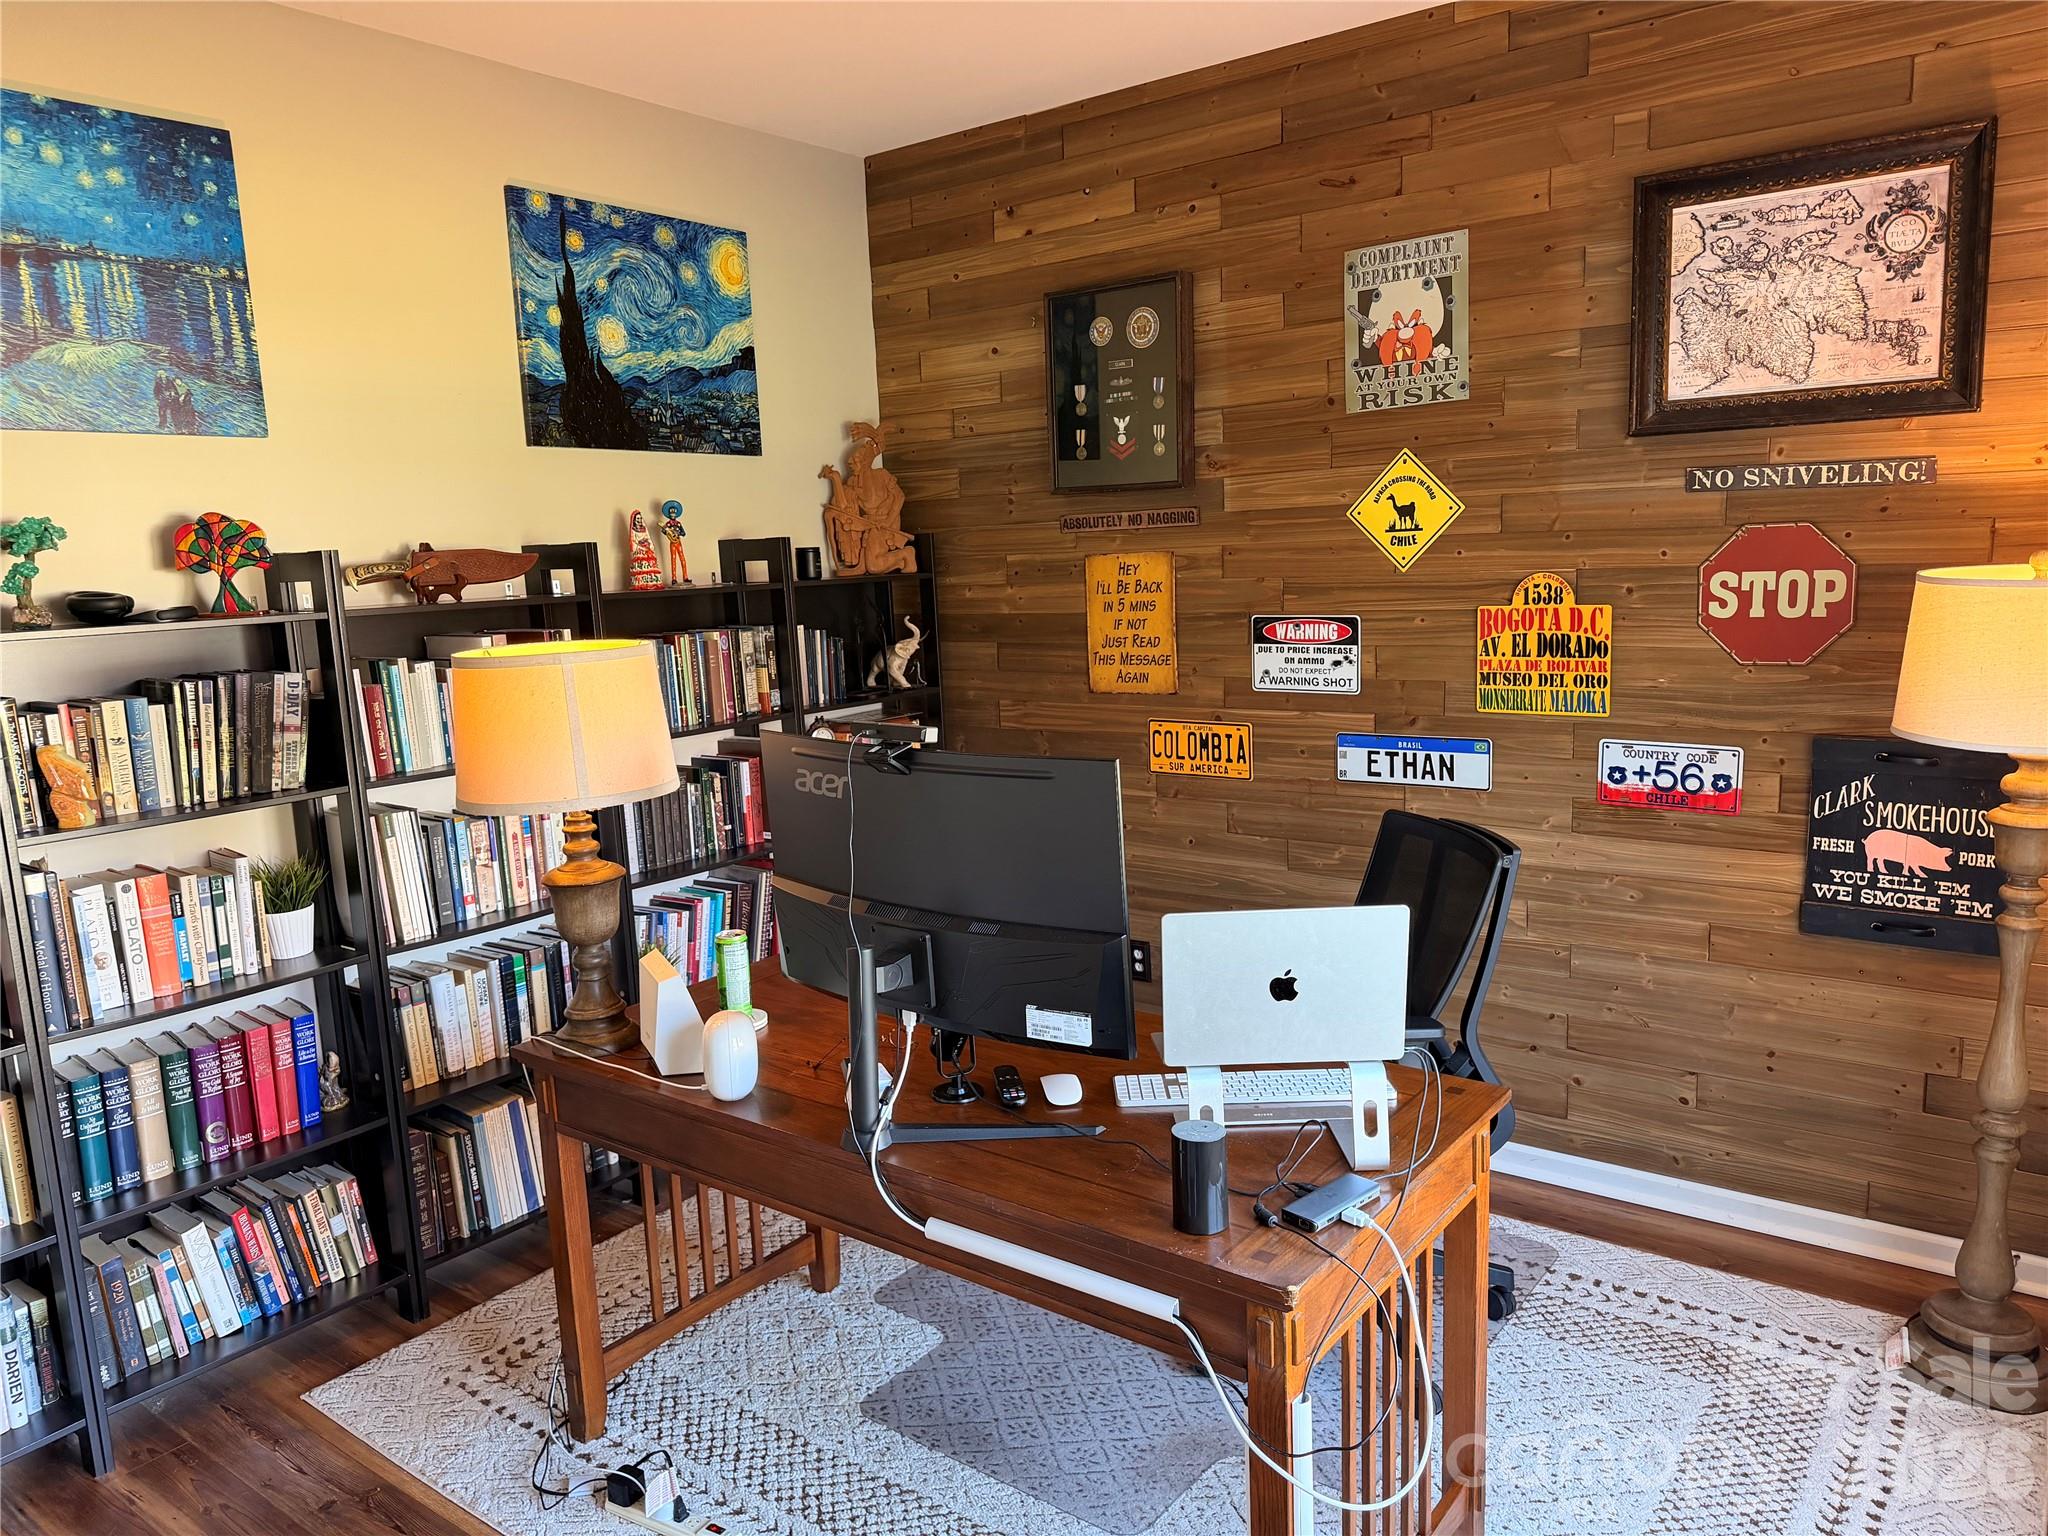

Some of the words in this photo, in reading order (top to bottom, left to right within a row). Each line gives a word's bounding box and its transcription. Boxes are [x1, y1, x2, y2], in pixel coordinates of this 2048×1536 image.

[1359, 235, 1455, 268] COMPLAINT
[1351, 254, 1462, 289] DEPARTMENT
[1354, 356, 1460, 384] WHINE
[1355, 384, 1373, 393] AT
[1377, 377, 1418, 391] YOUR
[1423, 372, 1458, 383] OWN
[1358, 382, 1454, 411] RISK
[1692, 469, 1734, 489] NO
[1743, 461, 1927, 488] SNIVELING!
[1373, 484, 1389, 504] ALPACA
[1388, 475, 1416, 487] CROSSING
[1416, 477, 1426, 487] THE
[1424, 485, 1437, 500] ROAD
[1062, 515, 1123, 530] ABSOLUTELY
[1127, 513, 1143, 527] NO
[1149, 510, 1195, 526] NAGGING
[1390, 534, 1418, 547] CHILE
[1523, 582, 1564, 606] 1538
[1542, 573, 1572, 596] COLOMBIA
[1708, 569, 1848, 619] STOP
[1118, 598, 1125, 612] 5
[1127, 618, 1148, 631] NOT
[1275, 623, 1339, 640] WARNING
[1479, 607, 1562, 641] BOGOTA
[1569, 607, 1610, 641] D.C.
[1258, 646, 1273, 654] DUE
[1275, 646, 1285, 654] TO
[1287, 646, 1311, 654] PRICE
[1313, 647, 1354, 655] INCREASE
[1479, 635, 1506, 657] AV.
[1511, 633, 1532, 658] EL
[1536, 632, 1609, 659] DORADO
[1284, 657, 1296, 665] ON
[1297, 657, 1325, 665] AMMO
[1479, 660, 1522, 672] PLAZA
[1525, 660, 1542, 672] DE
[1547, 660, 1608, 673] BOLIVAR
[1259, 676, 1267, 685] A
[1269, 676, 1320, 687] WARNING
[1323, 677, 1354, 688] SHOT
[1479, 672, 1533, 687] MUSEO
[1538, 673, 1568, 688] DEL
[1573, 674, 1608, 689] ORO
[1478, 688, 1547, 712] MONSERRATE
[1549, 690, 1607, 714] MALOKA
[76, 723, 89, 752] HUNTING
[1152, 729, 1247, 765] COLOMBIA
[1398, 741, 1423, 750] BRASIL
[1367, 750, 1455, 782] ETHAN
[1623, 749, 1680, 762] COUNTRY
[1687, 753, 1718, 764] CODE
[117, 752, 131, 796] AMERICA
[140, 748, 156, 792] AMERICA
[1169, 761, 1185, 772] SUR
[1190, 763, 1229, 775] AMERICA
[1339, 769, 1348, 778] BR
[1632, 760, 1705, 795] +56
[794, 768, 849, 799] acer
[1646, 792, 1689, 806] CHILE
[1813, 773, 1877, 819] CLARK
[1862, 800, 1996, 839] SMOKEHOUS
[1812, 836, 1855, 854] FRESH
[1958, 851, 1996, 869] PORK
[1829, 869, 1871, 886] YOU
[1877, 874, 1926, 893] KILL
[1812, 883, 1853, 901] WE
[1860, 888, 1941, 913] SMOKE
[188, 902, 199, 924] Travels
[84, 900, 100, 949] PLATO
[191, 924, 201, 940] with
[49, 887, 66, 942] AMERICA'S
[60, 944, 70, 970] WILD
[65, 971, 76, 1000] WEST
[126, 916, 144, 965] PLATO
[178, 930, 190, 962] HAMLET
[34, 940, 49, 970] Medal
[194, 941, 204, 966] Charley
[40, 971, 51, 981] of
[42, 982, 54, 1014] Honor
[296, 1029, 314, 1038] WORK
[296, 1037, 315, 1046] GLORY
[198, 1060, 220, 1070] WORK
[222, 1051, 242, 1061] WORK
[222, 1060, 243, 1070] GLORY
[168, 1068, 189, 1078] WORK
[168, 1076, 190, 1086] GLORY
[198, 1068, 222, 1078] GLORY
[76, 1094, 102, 1106] WORK
[105, 1085, 129, 1097] WORK
[106, 1094, 130, 1106] GLORY
[77, 1102, 103, 1115] GLORY
[305, 1111, 320, 1120] LUND
[8, 1106, 20, 1146] FIGHTER
[14, 1150, 24, 1174] PILOT
[231, 1132, 253, 1143] LUND
[182, 1154, 199, 1162] LUND
[210, 1144, 229, 1155] LUND
[465, 1134, 475, 1167] SUPERSONIC
[470, 1167, 479, 1190] SAINTS
[117, 1170, 140, 1182] LUND
[88, 1181, 113, 1193] LUND
[309, 1196, 321, 1218] FINAL
[316, 1218, 328, 1235] DAYS
[230, 1246, 240, 1264] BIG
[247, 1241, 262, 1259] WARS
[110, 1280, 125, 1304] 1920
[4, 1348, 24, 1405] DARIEN
